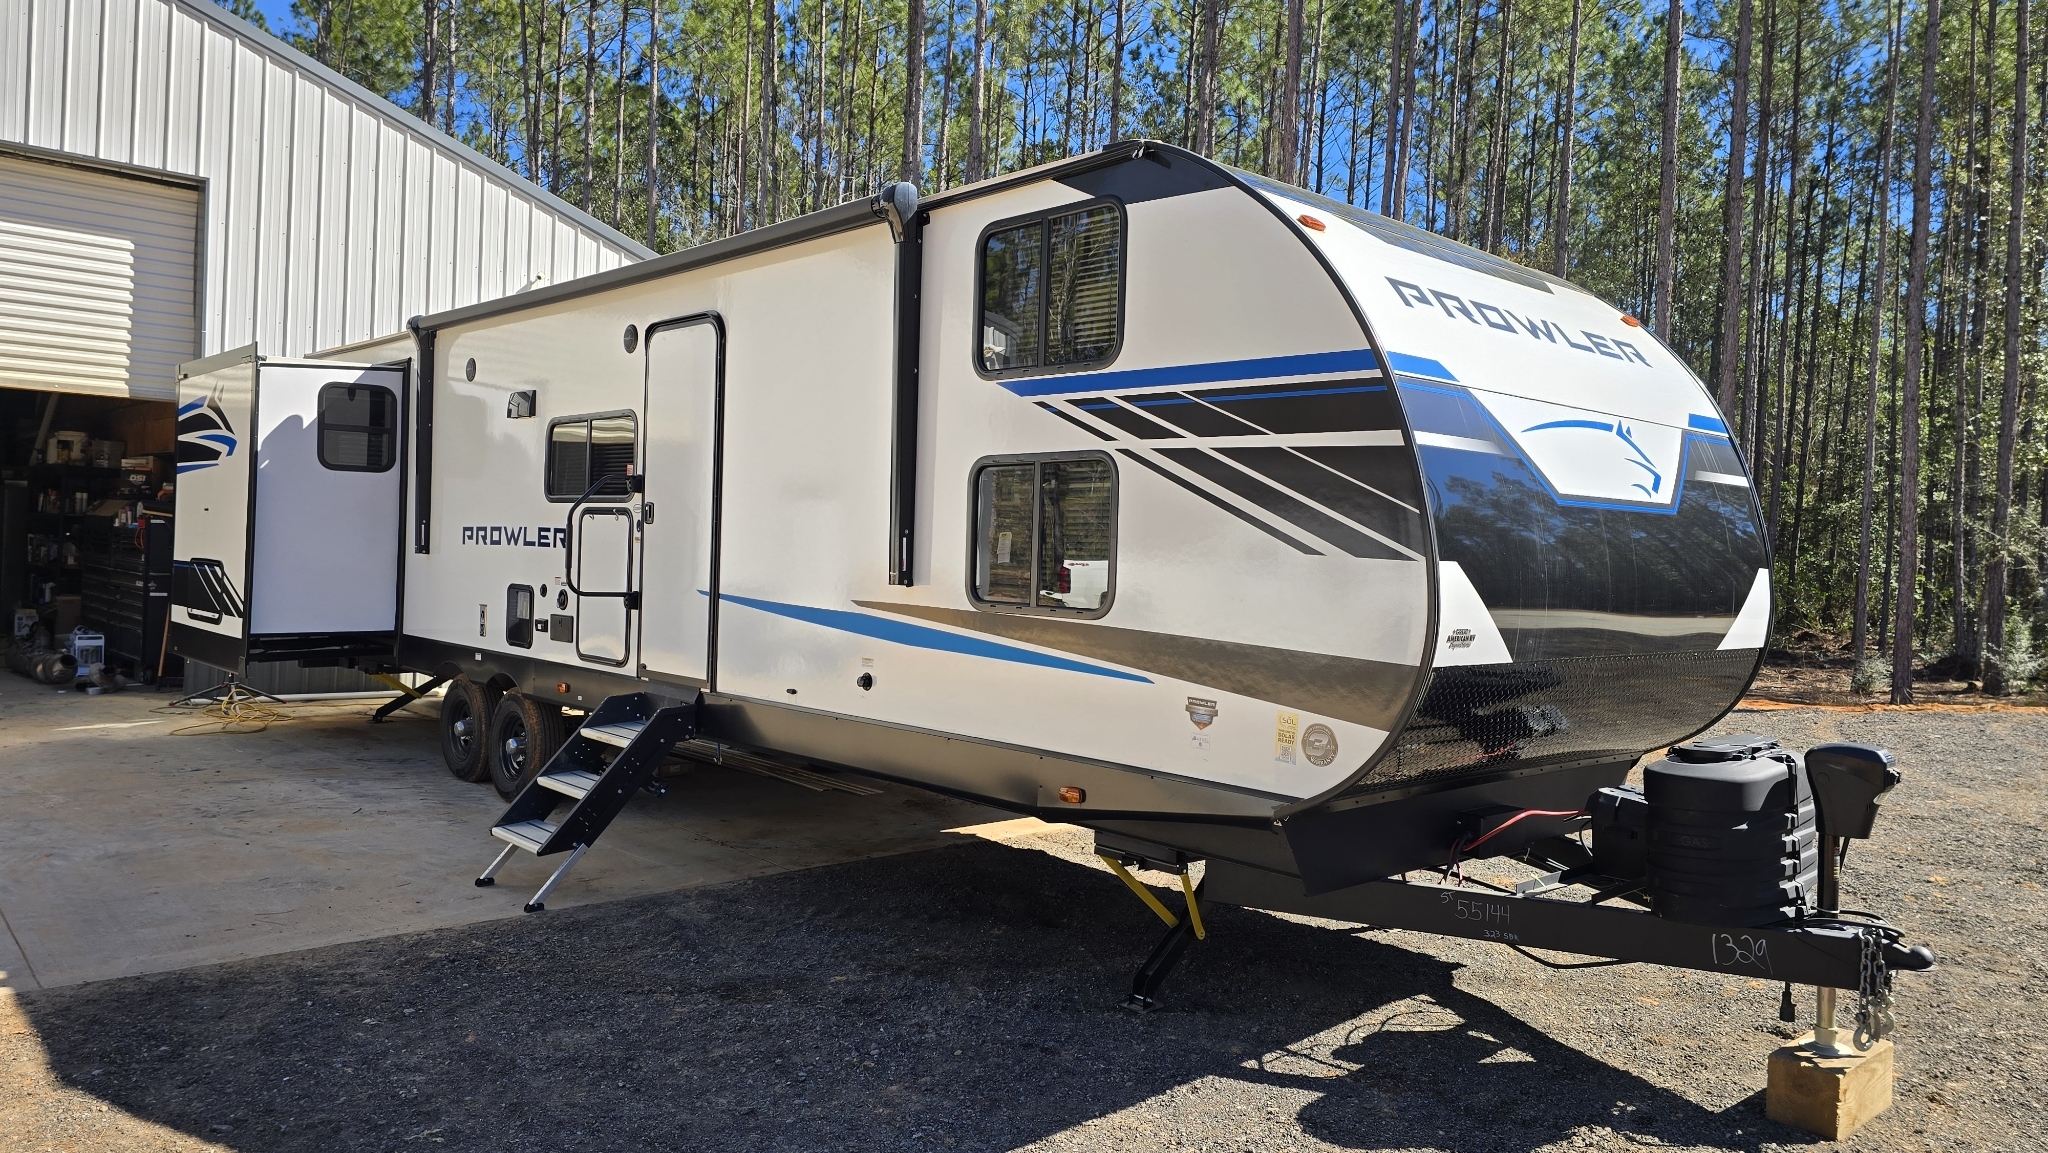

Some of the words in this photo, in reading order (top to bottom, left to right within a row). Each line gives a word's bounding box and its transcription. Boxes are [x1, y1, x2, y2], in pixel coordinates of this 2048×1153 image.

[1384, 276, 1653, 368] PROWLER
[462, 526, 566, 548] PROWLER
[1680, 835, 1708, 848] GAS
[1454, 899, 1510, 925] 55144
[1484, 929, 1501, 940] 323
[1711, 932, 1773, 976] 1329
